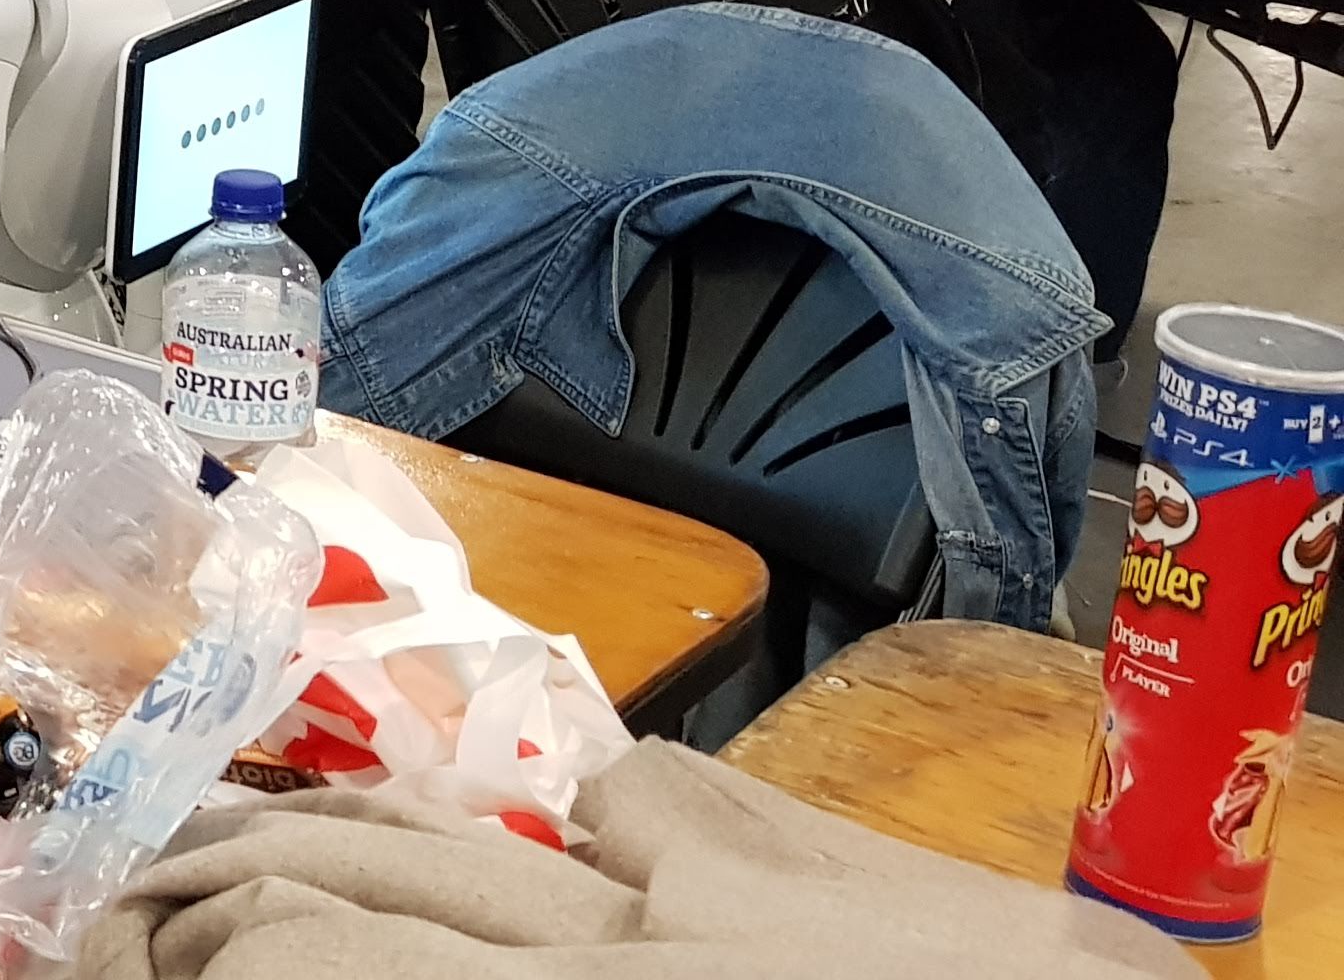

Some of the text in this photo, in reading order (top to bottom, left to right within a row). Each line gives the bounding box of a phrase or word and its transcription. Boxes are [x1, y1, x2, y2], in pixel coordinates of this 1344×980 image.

[176, 321, 293, 352] AUSTRALIAN
[175, 366, 289, 402] SPRING
[1158, 360, 1258, 420] WIN PS4
[176, 390, 287, 426] WATER
[1173, 427, 1255, 469] PS4
[1111, 615, 1180, 664] Original
[1122, 664, 1172, 698] PLAYER
